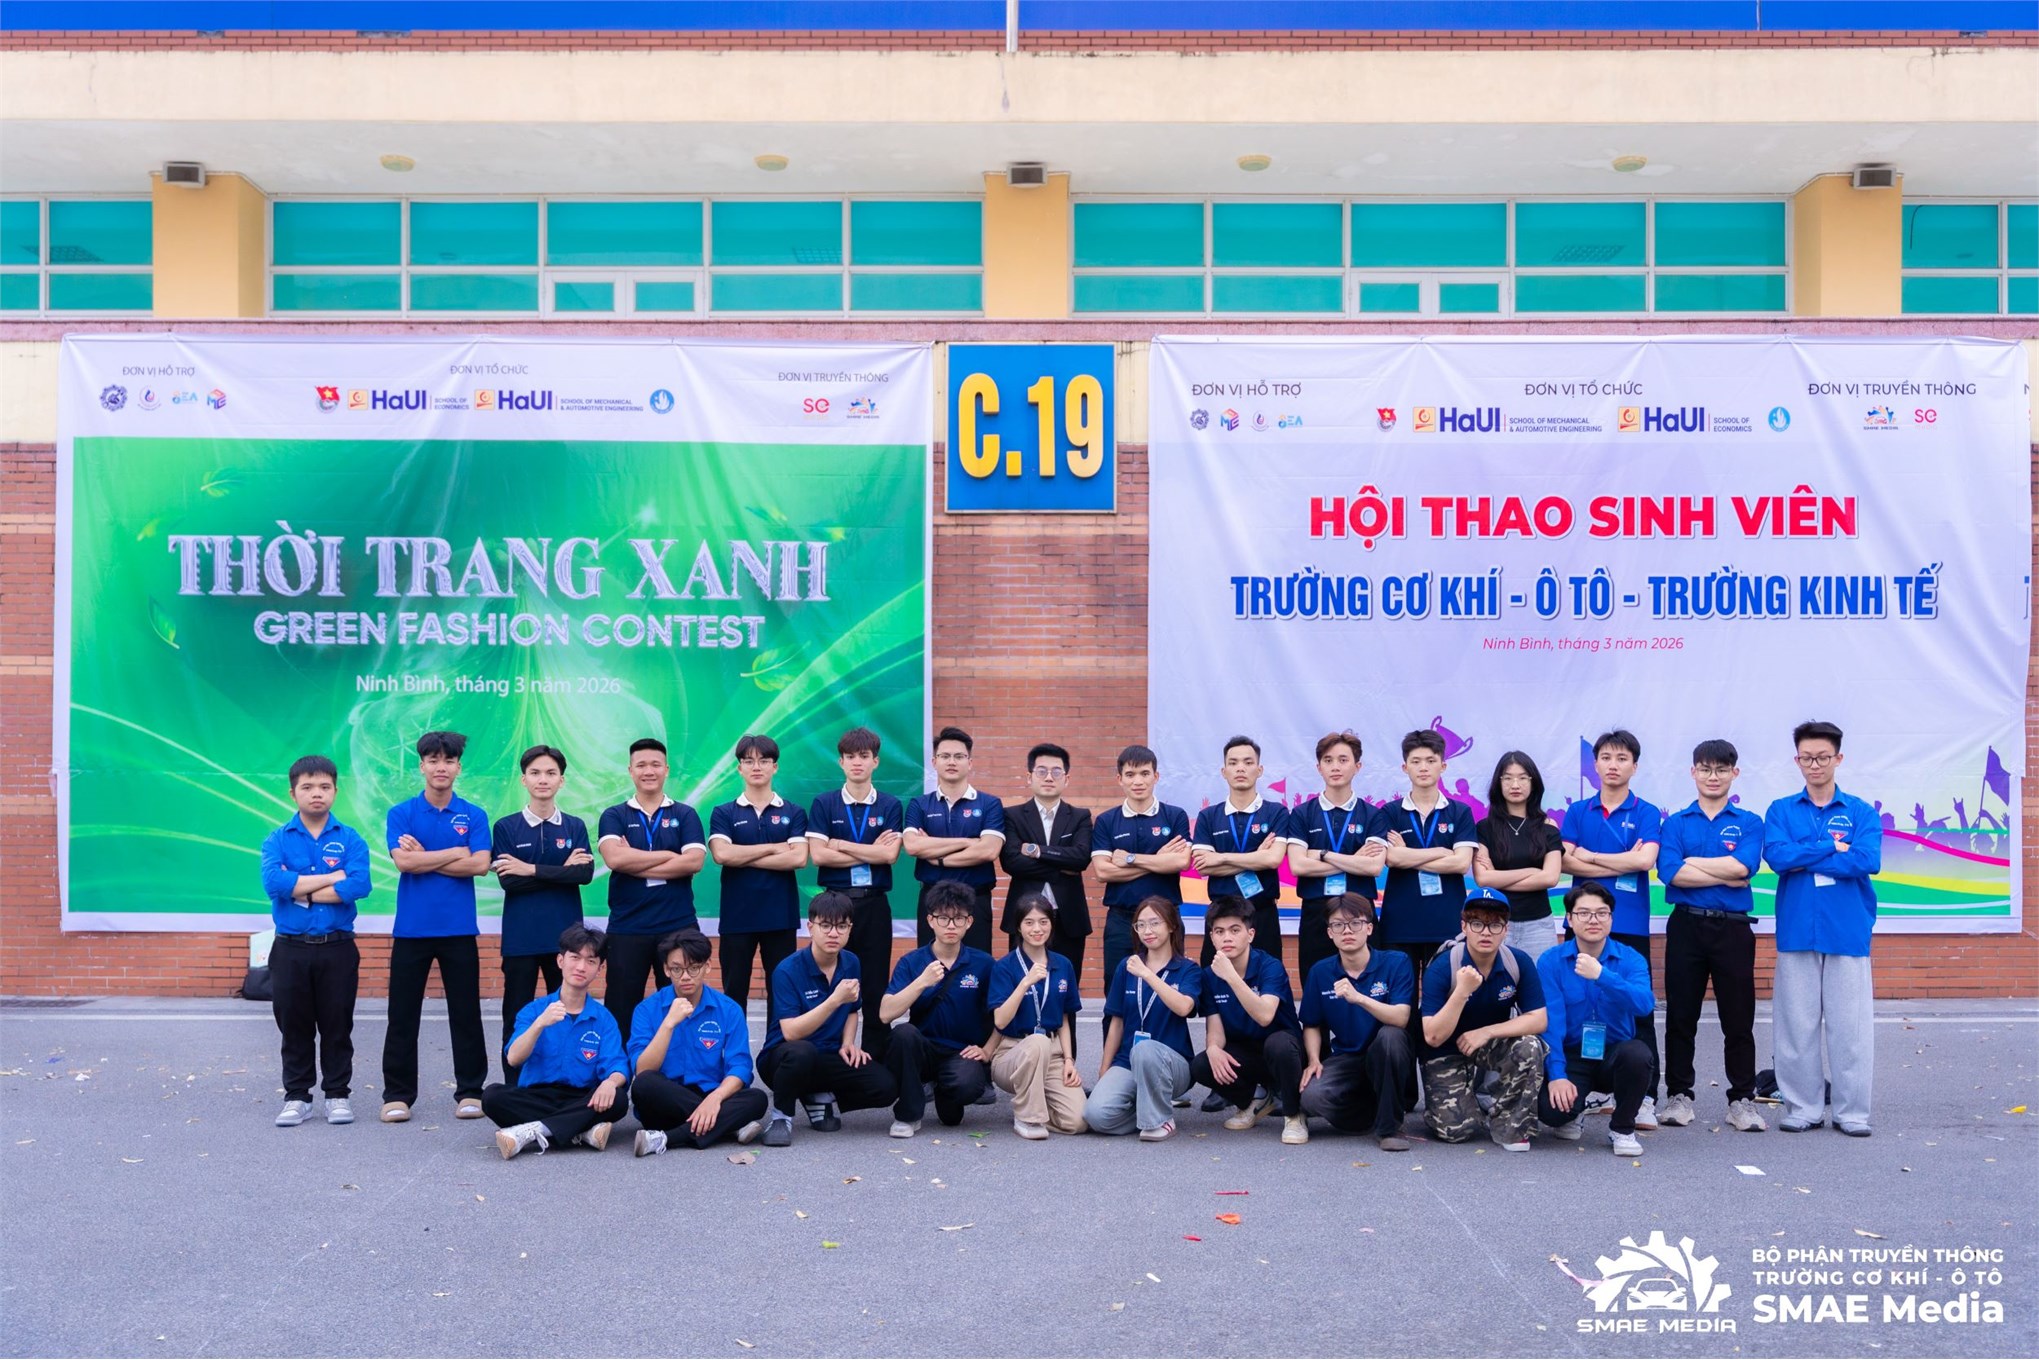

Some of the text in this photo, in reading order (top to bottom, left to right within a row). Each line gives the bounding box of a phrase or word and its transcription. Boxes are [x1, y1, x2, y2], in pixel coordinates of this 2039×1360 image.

[122, 366, 144, 376] ĐƠN
[147, 366, 157, 377] VỊ
[176, 366, 196, 377] TRỢ
[450, 365, 472, 375] ĐƠN
[474, 365, 484, 376] VỊ
[778, 371, 889, 383] ĐƠN VỊ TRUYỀN THÔNG
[1191, 379, 1302, 398] ĐƠN VỊ HỖ TRỢ
[1524, 379, 1643, 398] ĐƠN VỊ TỔ CHỨC
[1807, 379, 1977, 398] ĐƠN VỊ TRUYỀN THÔNG
[371, 390, 427, 410] HaUI
[498, 390, 553, 410] HaUI
[957, 371, 1105, 480] C.19
[1439, 407, 1500, 433] HaUI
[1559, 425, 1602, 433] ENGINEERING
[1644, 407, 1705, 432] HaUI
[1310, 484, 1857, 550] HỘI THAO SINH VIÊN
[168, 520, 831, 601] THỜI TRANG XANH
[1230, 563, 1942, 617] TRƯỜNG CƠ KHÍ - Ô TÔ - TRƯỜNG KINH TẾ
[253, 610, 766, 648] GREEN FASHION CONTEST
[1482, 637, 1684, 652] Ninh Bình, tháng 3 năm 2026
[356, 674, 621, 697] Ninh Bình, tháng 3 năm 2026
